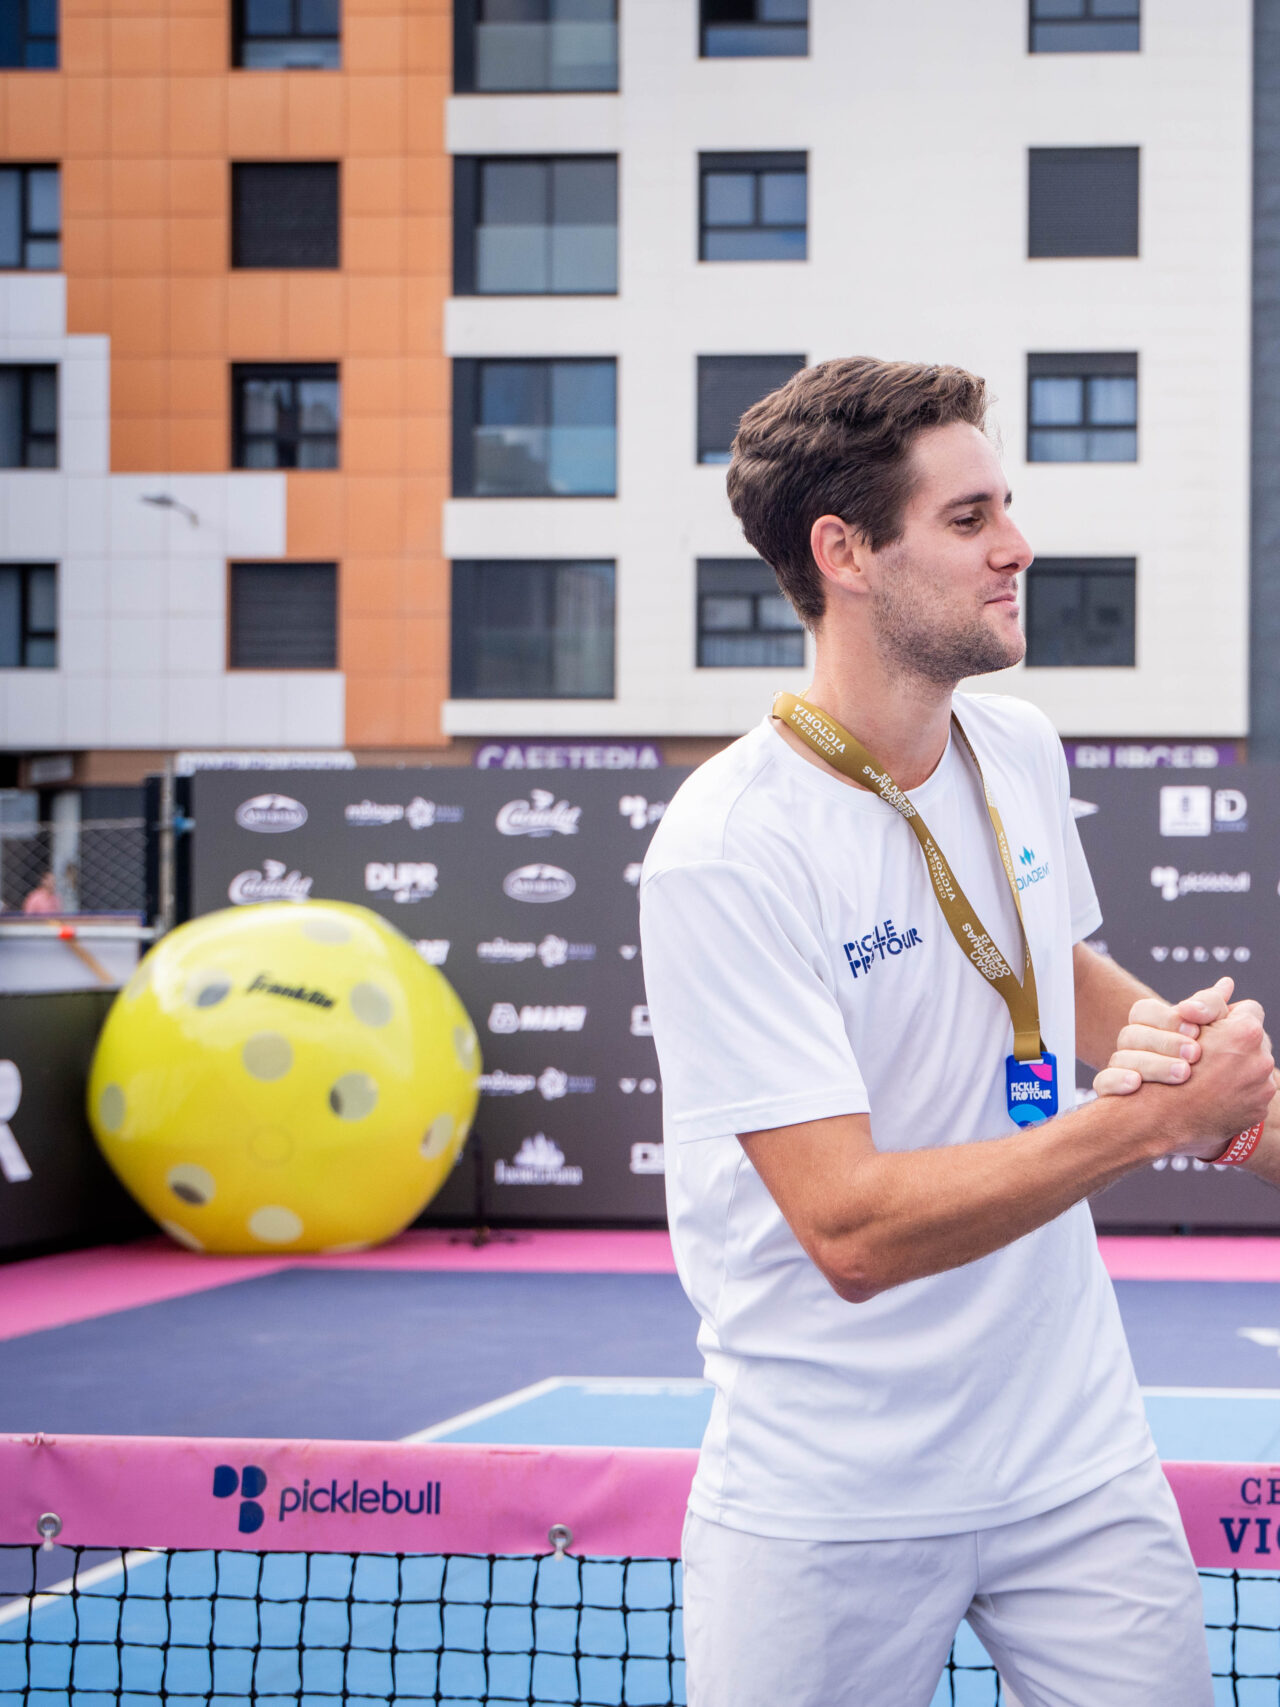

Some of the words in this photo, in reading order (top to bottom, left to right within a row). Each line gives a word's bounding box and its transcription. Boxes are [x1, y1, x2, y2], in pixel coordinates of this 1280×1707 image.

[790, 713, 836, 756] CERVEZAS
[794, 704, 846, 753] VICTORIA
[962, 923, 1004, 978] CANARIAS
[1151, 946, 1250, 963] VOLVO
[1222, 1128, 1249, 1163] ORIA
[1235, 1122, 1260, 1162] VEZAS
[279, 1478, 441, 1522] picklebull
